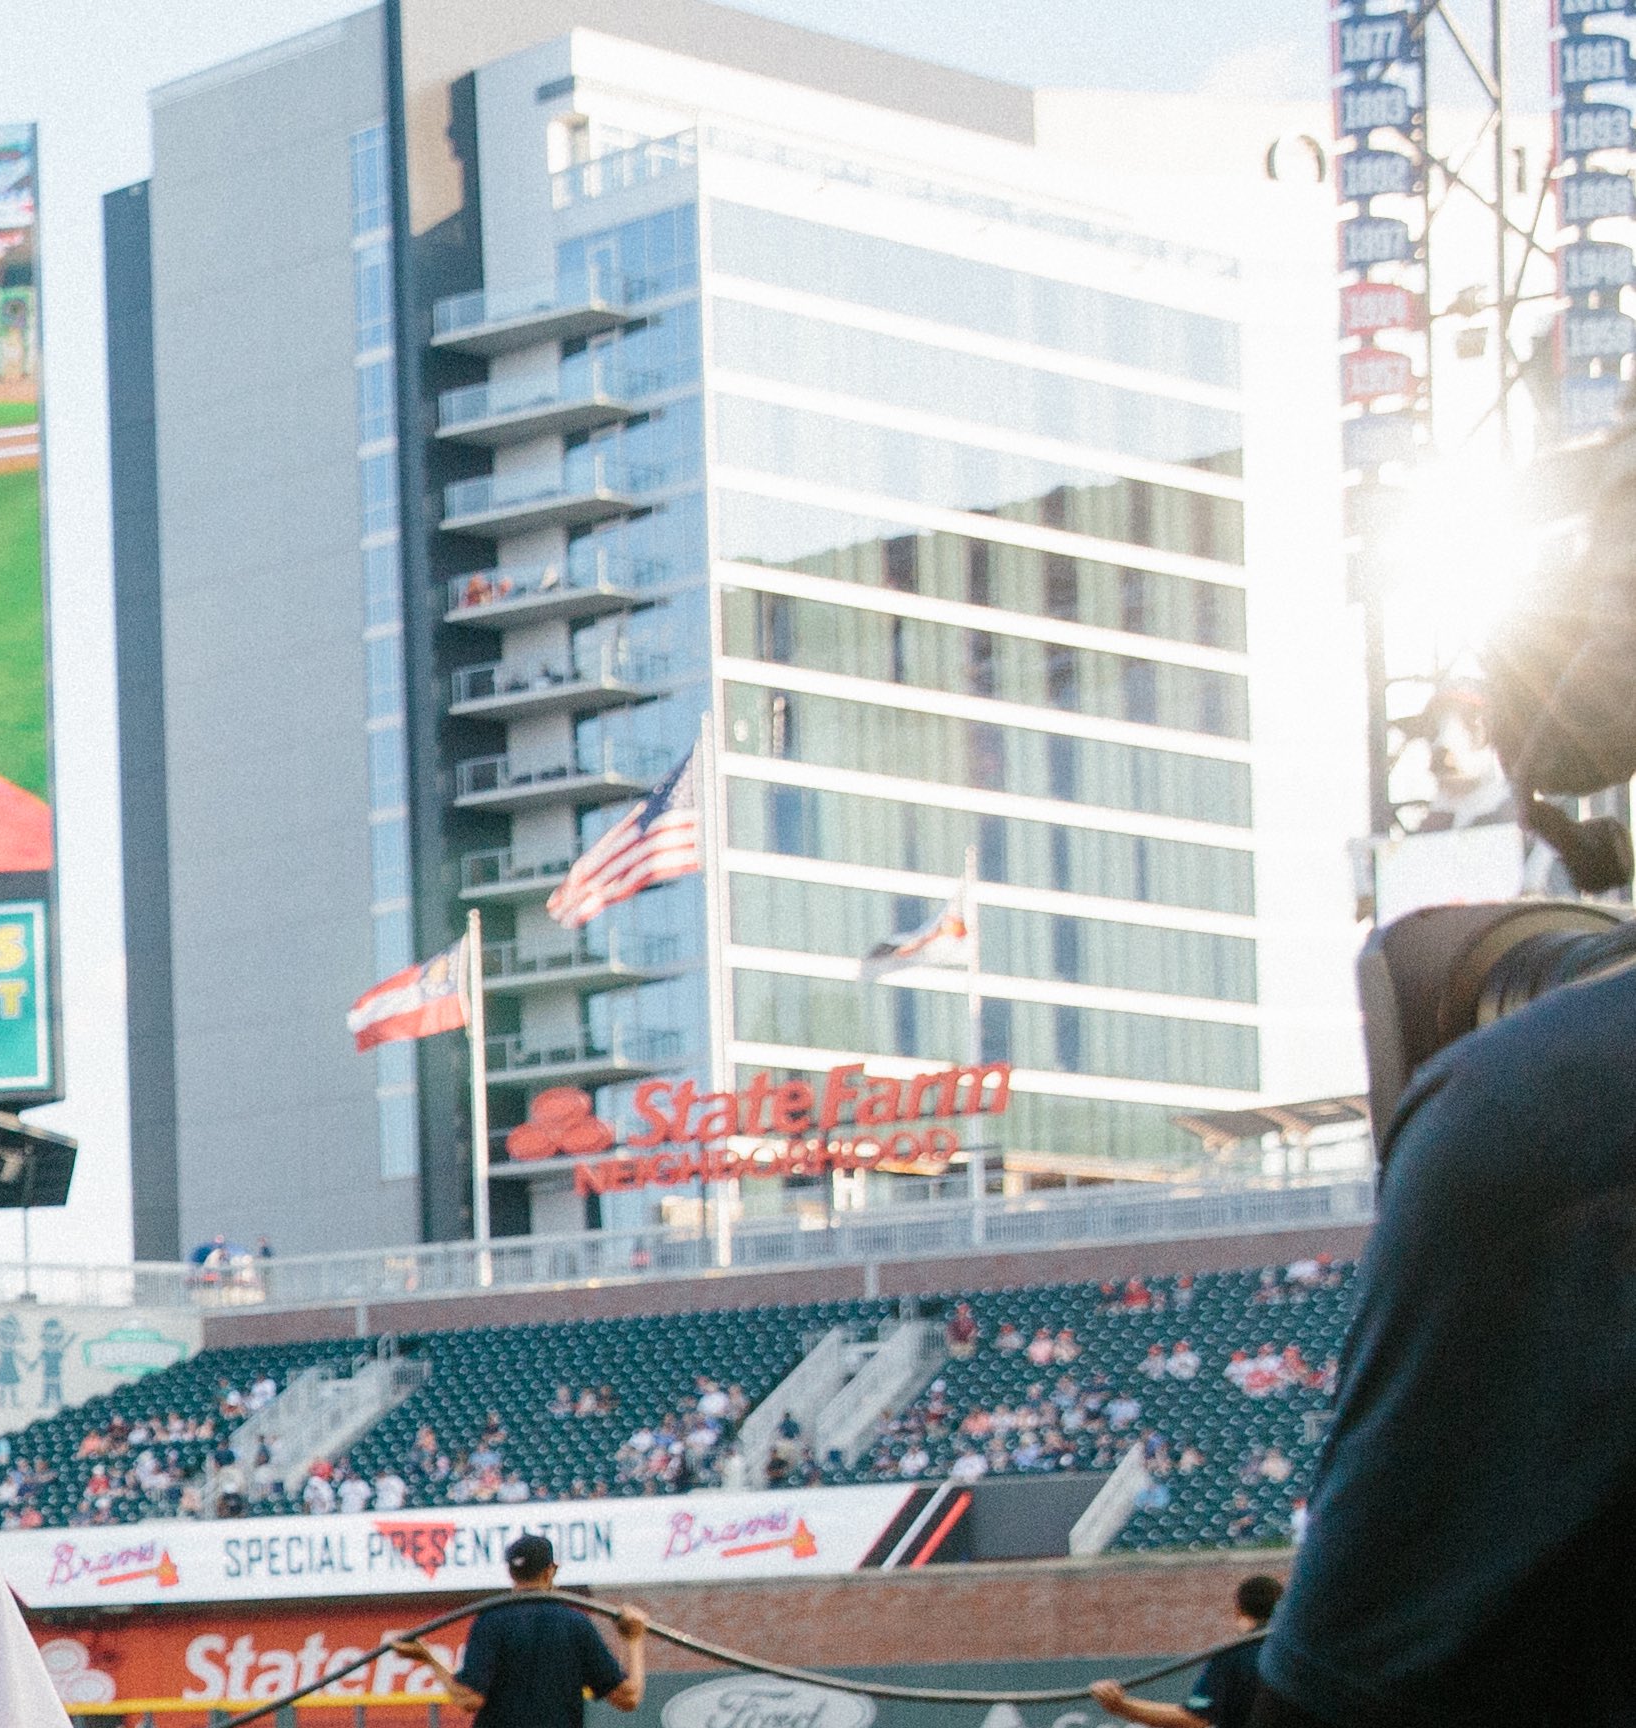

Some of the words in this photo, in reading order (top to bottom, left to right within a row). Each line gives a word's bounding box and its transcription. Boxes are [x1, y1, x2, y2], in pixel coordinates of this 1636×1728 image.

[573, 1127, 960, 1197] NEIGHBORHOOD
[223, 1533, 354, 1578] SPECIAL
[368, 1519, 613, 1572] PRESENTTION
